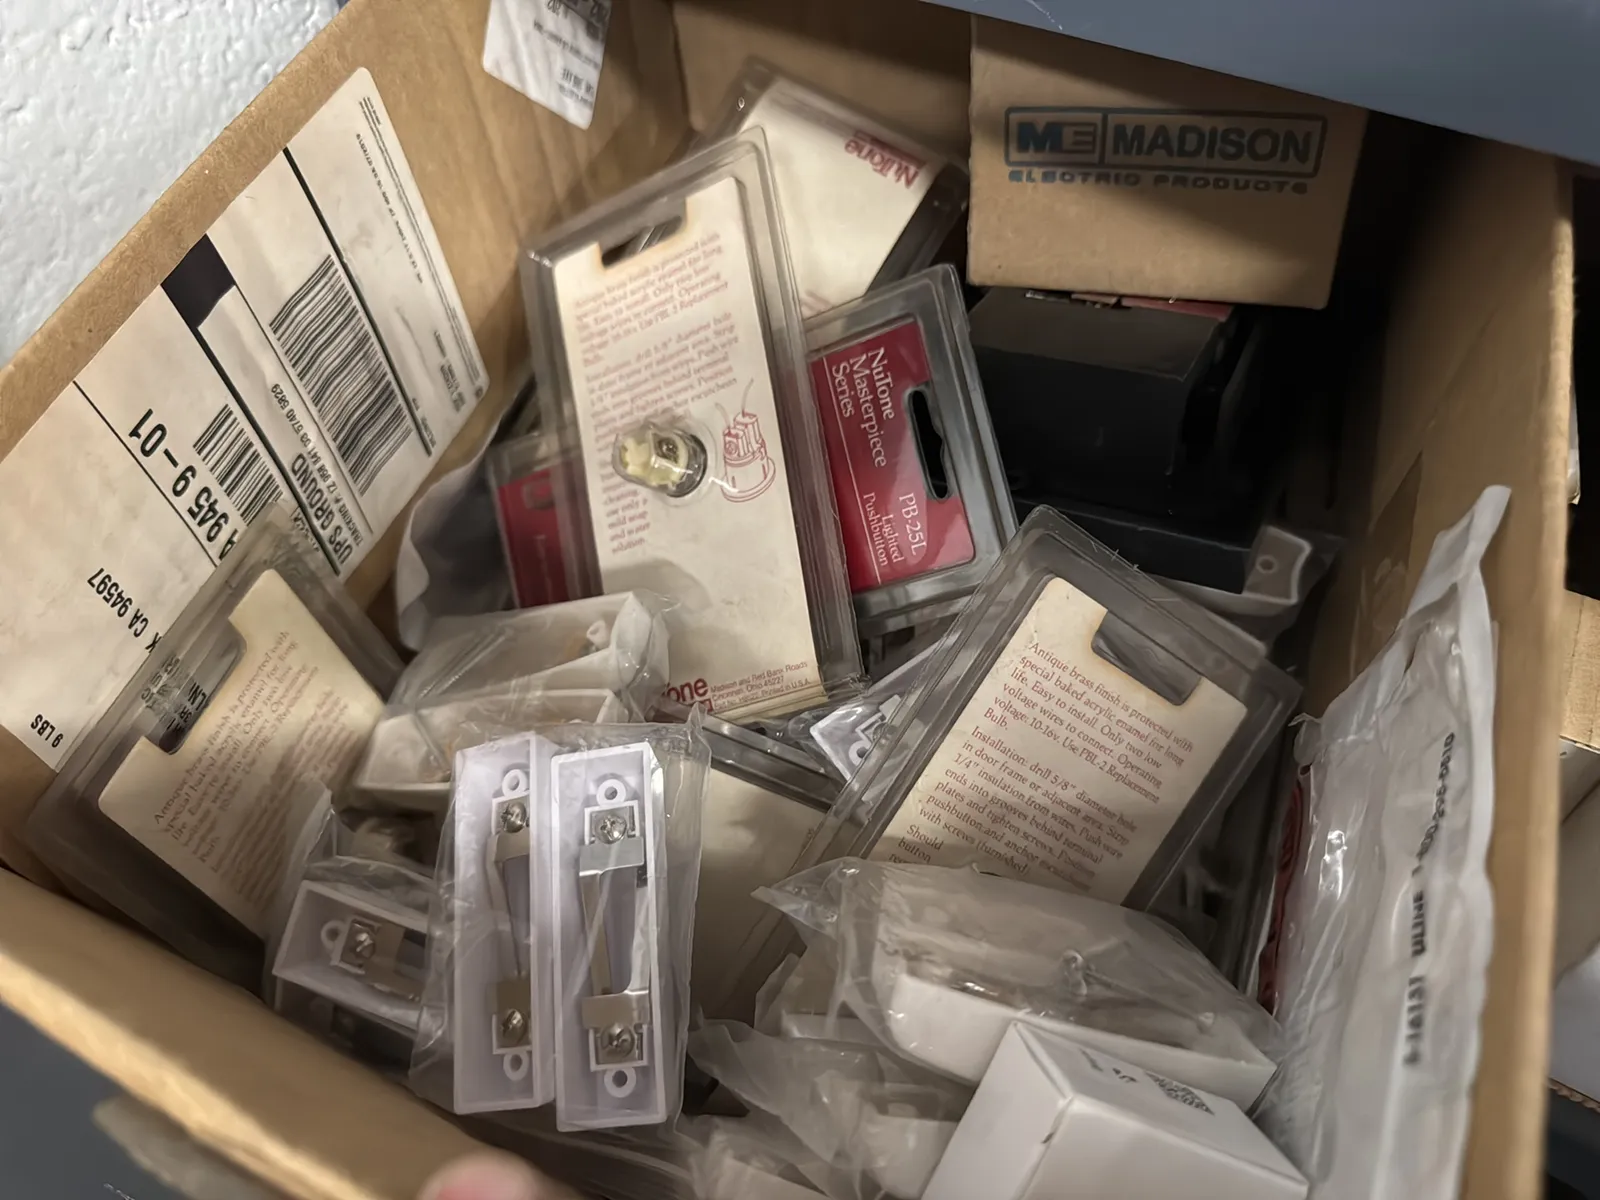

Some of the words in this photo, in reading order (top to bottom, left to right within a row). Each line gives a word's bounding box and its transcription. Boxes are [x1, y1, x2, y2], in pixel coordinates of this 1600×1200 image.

[845, 141, 918, 188] NuTone
[1112, 124, 1312, 164] MADISON
[1008, 169, 1141, 187] ELECTRIC
[1153, 173, 1309, 195] PRODUCTS
[832, 361, 854, 416] Series
[868, 348, 893, 418] NuTone
[844, 355, 885, 465] Masterpiece
[129, 410, 196, 496] 9-01
[187, 486, 228, 541] 945
[290, 454, 334, 529] GROUND
[327, 524, 352, 563] UPS
[337, 503, 361, 545] TRACKING
[863, 492, 888, 565] Pushbutton
[878, 514, 903, 562] Lighted
[899, 493, 926, 554] PB-25L
[87, 568, 132, 616] 94597
[127, 608, 148, 637] CA
[666, 678, 708, 702] one
[1016, 656, 1054, 682] special
[1053, 675, 1086, 700] baked
[1083, 698, 1116, 726] acrylic
[1028, 642, 1068, 672] Antique
[1068, 666, 1094, 689] brass
[1093, 683, 1120, 706] finish
[1128, 708, 1173, 739] protected
[30, 714, 55, 740] LBS
[51, 732, 63, 748] 9
[983, 706, 1007, 729] Bulb.
[1003, 683, 1038, 709] voltage
[1039, 706, 1064, 726] wires
[1064, 722, 1077, 733] to
[1115, 753, 1161, 788] Operating
[1030, 680, 1055, 702] Easy
[1054, 697, 1066, 709] to
[1100, 723, 1124, 746] Only
[1124, 740, 1144, 757] two
[1143, 751, 1162, 768] low
[1061, 736, 1079, 754] Use
[974, 747, 999, 766] door
[998, 760, 1028, 784] frame
[1041, 789, 1081, 815] adjacent
[977, 767, 1025, 800] insulation
[1024, 794, 1050, 816] from
[1028, 762, 1052, 779] drill
[919, 807, 941, 824] with
[934, 781, 964, 802] plates
[965, 799, 988, 814] and
[944, 768, 968, 785] ends
[968, 780, 989, 798] into
[988, 793, 1028, 820] grooves
[1029, 814, 1063, 841] behind
[906, 823, 943, 850] Should
[926, 789, 982, 829] pushbutton
[983, 827, 1006, 842] and
[1003, 839, 1038, 861] anchor
[897, 836, 931, 864] button
